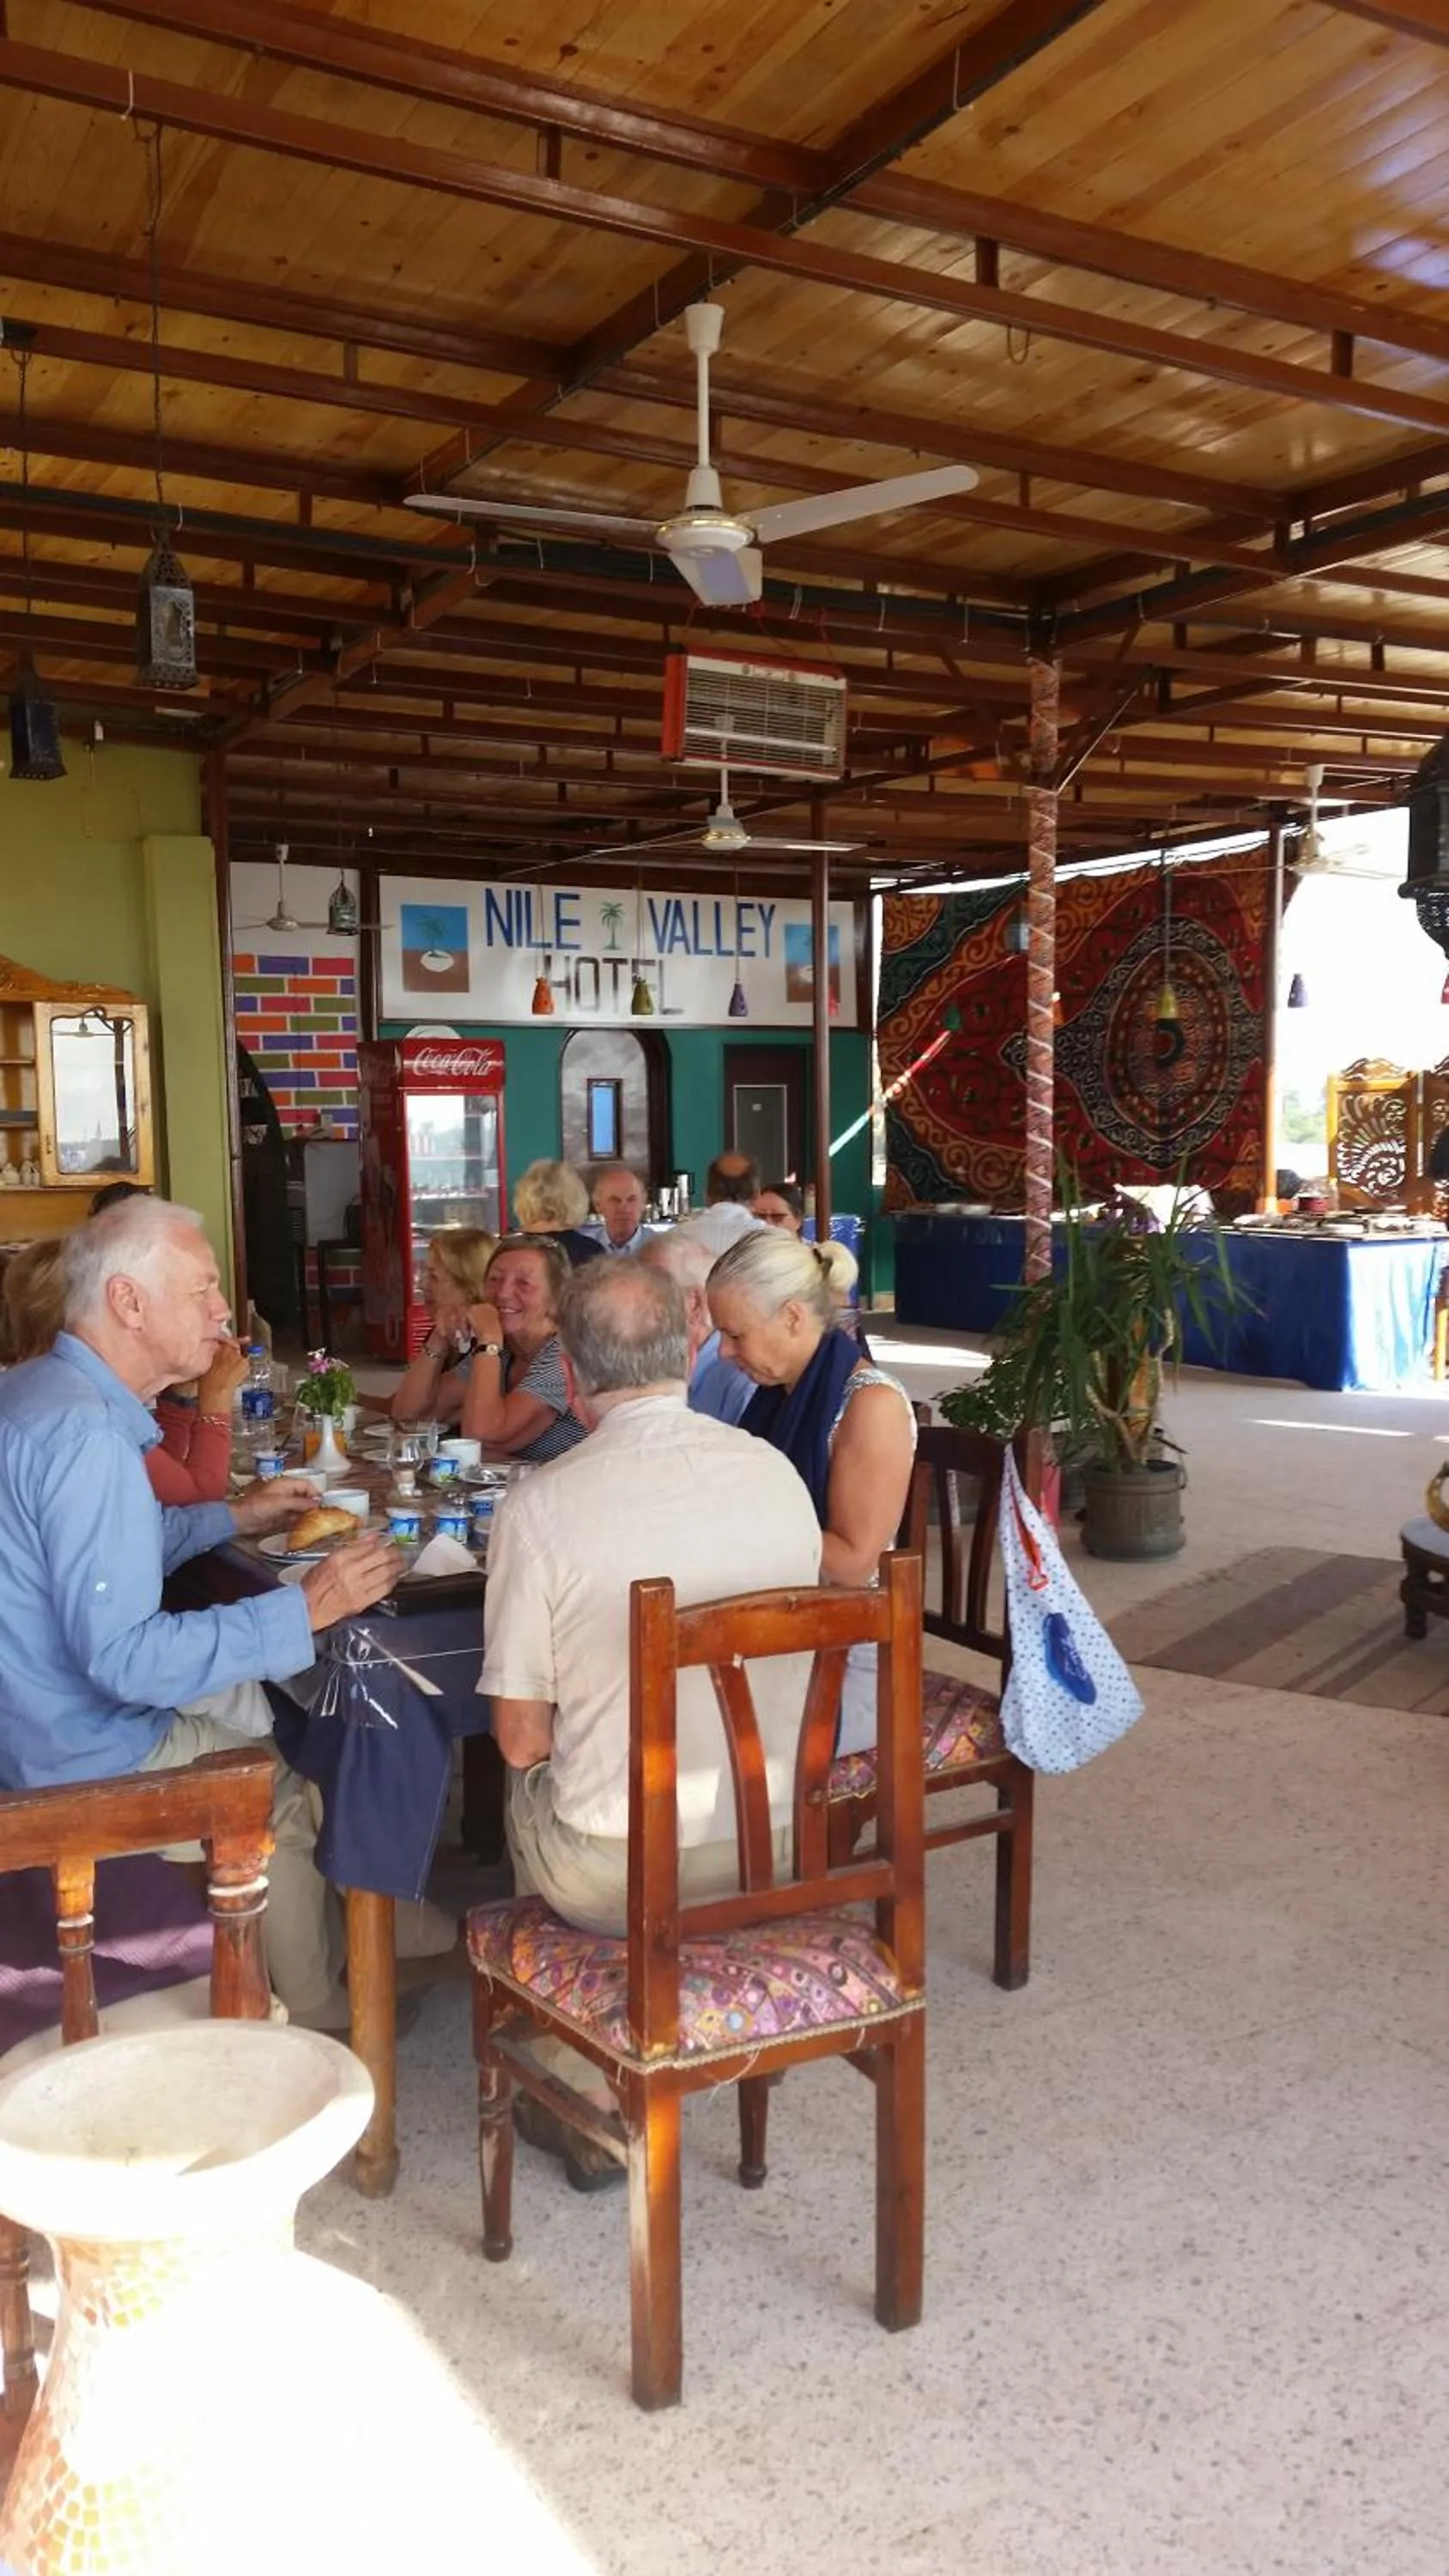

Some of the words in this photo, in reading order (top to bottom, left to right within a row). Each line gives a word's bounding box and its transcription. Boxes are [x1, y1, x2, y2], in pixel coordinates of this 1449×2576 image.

[485, 888, 581, 950] NILE
[647, 897, 776, 958] VALLEY
[412, 1047, 494, 1077] Coca-Cola
